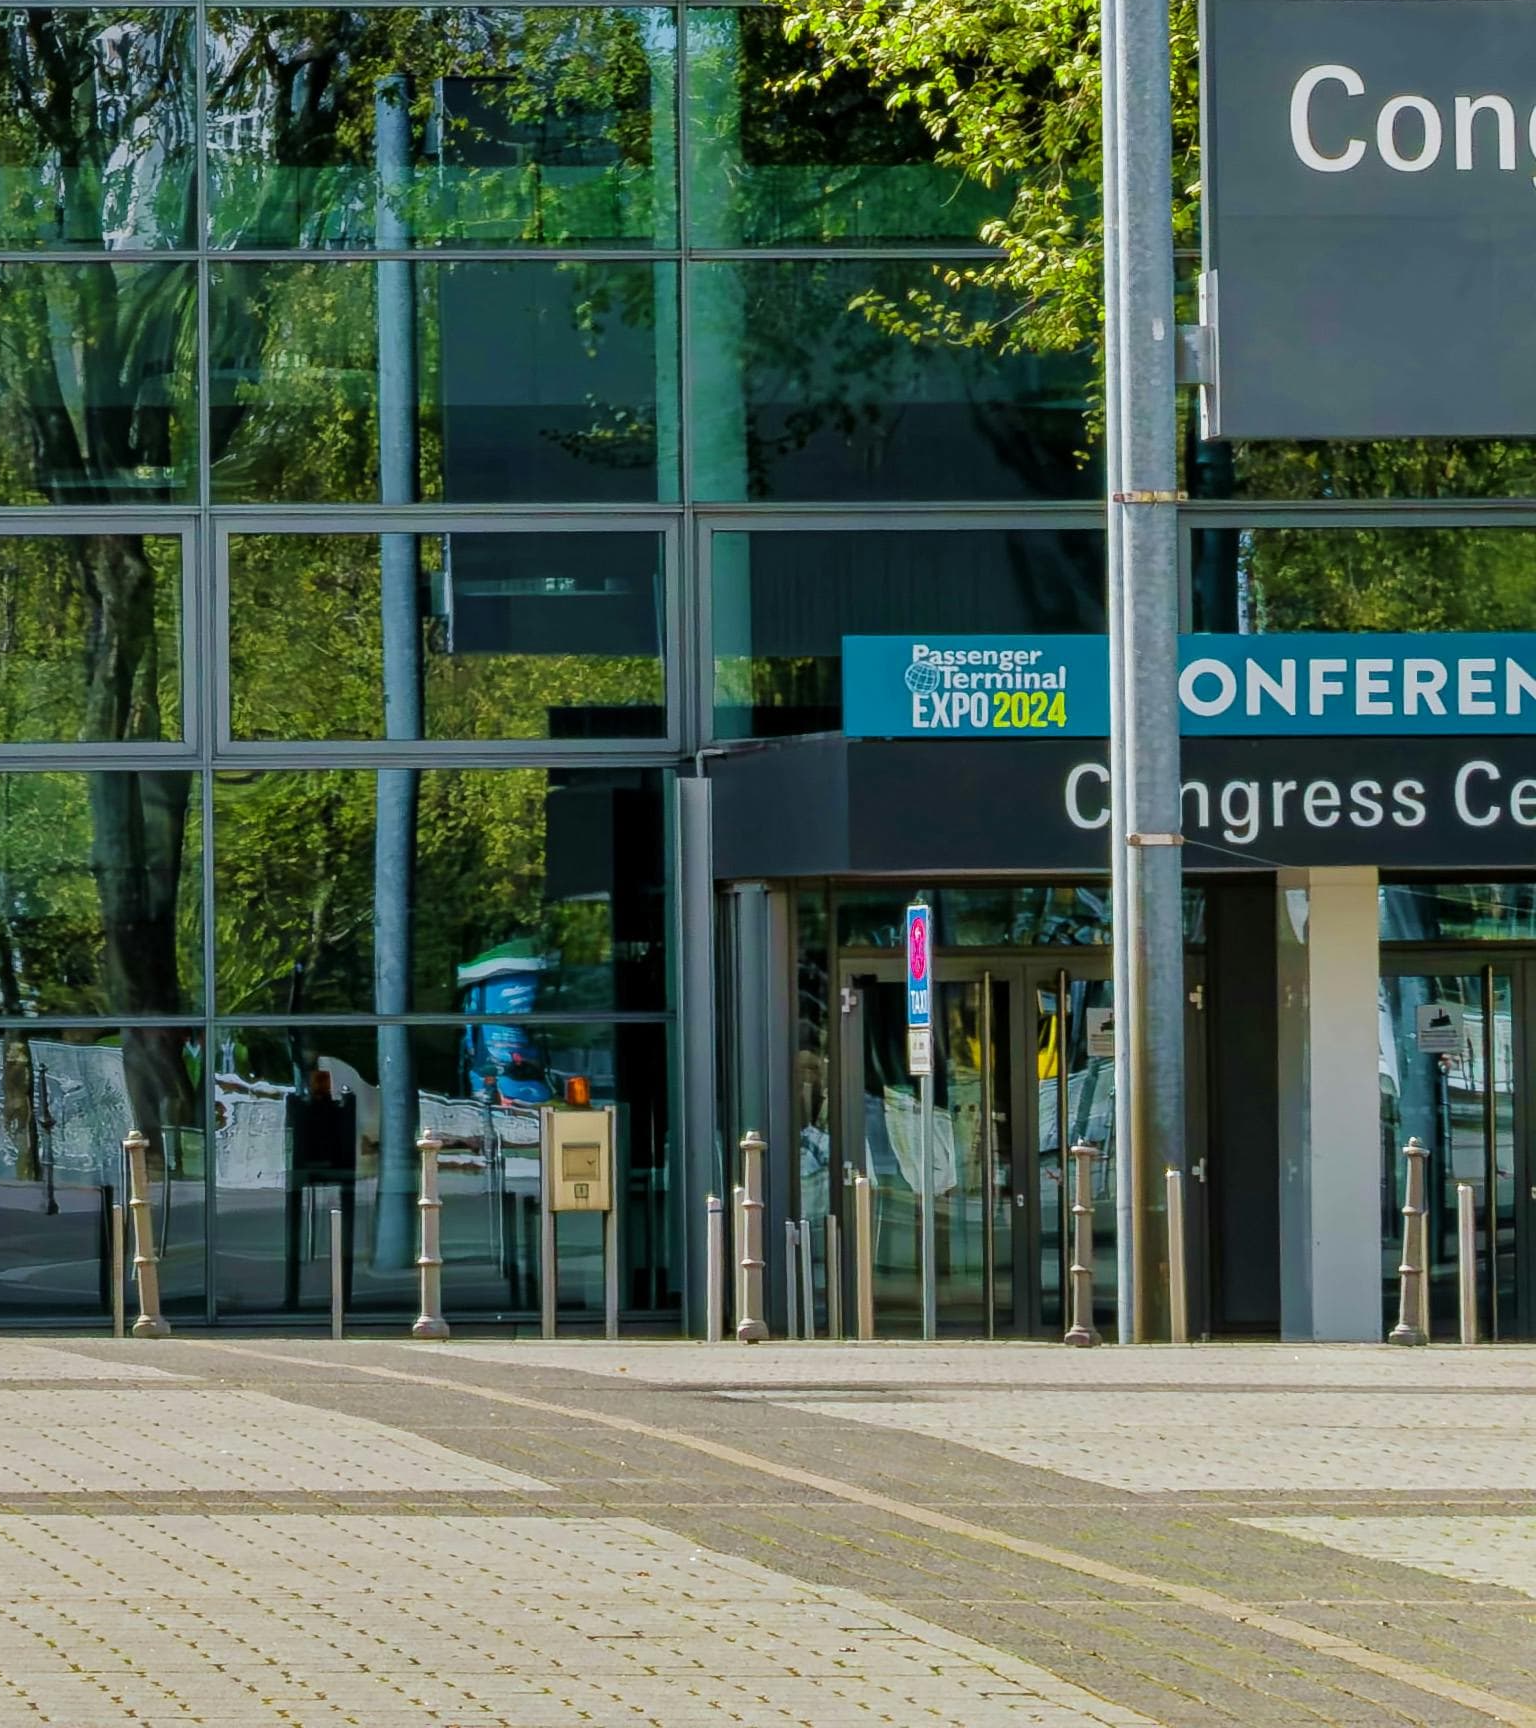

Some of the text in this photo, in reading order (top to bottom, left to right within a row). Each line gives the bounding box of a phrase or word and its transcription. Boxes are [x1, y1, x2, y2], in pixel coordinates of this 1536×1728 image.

[1290, 64, 1536, 190] Cong
[912, 644, 1043, 671] Passenger
[938, 665, 1067, 689] Terminal
[1178, 657, 1536, 717] ONFEREN
[912, 691, 1068, 728] EXPO 2024
[1065, 762, 1426, 844] Cngress
[911, 989, 928, 1014] TAXI
